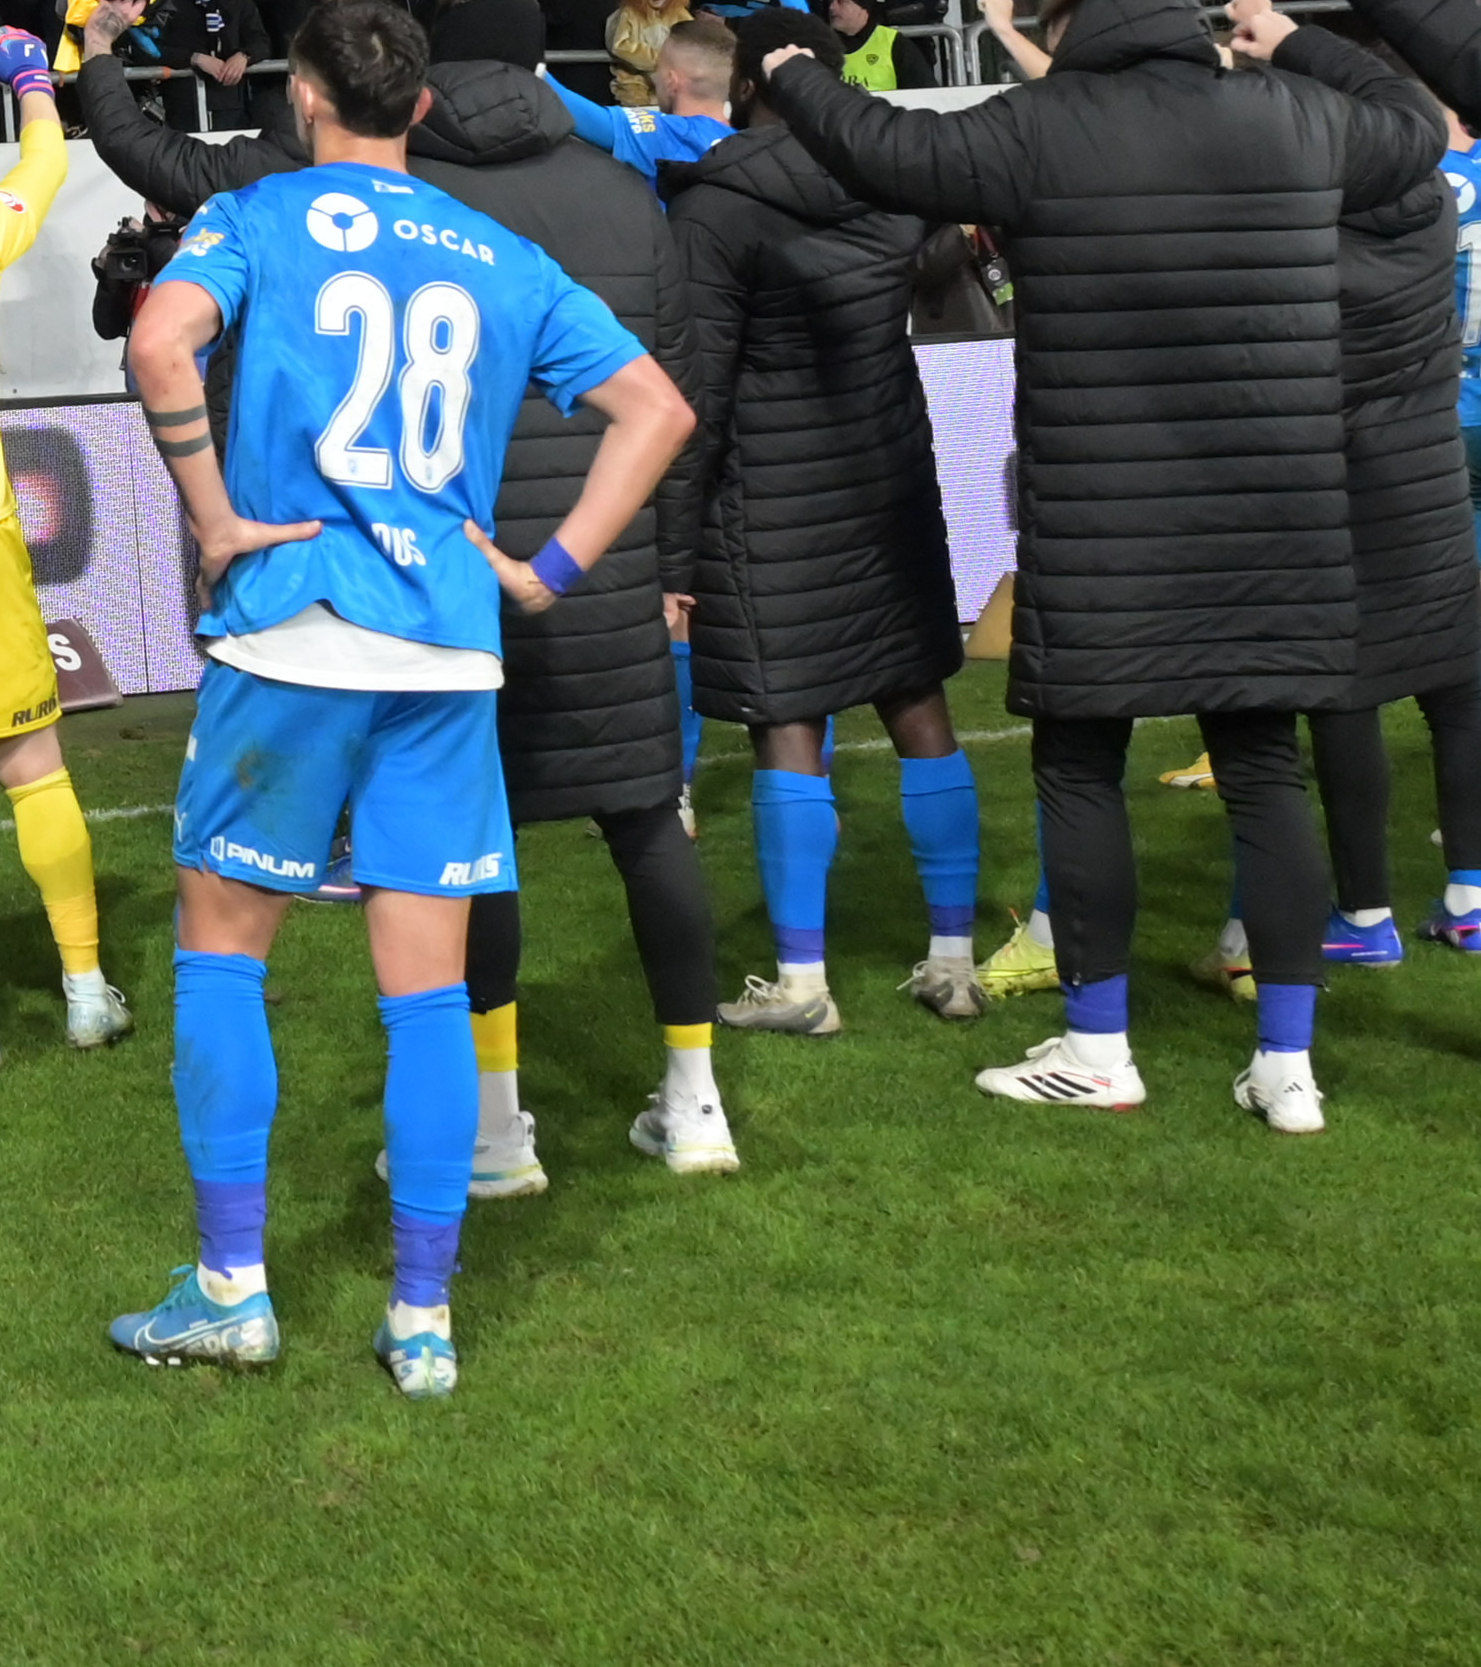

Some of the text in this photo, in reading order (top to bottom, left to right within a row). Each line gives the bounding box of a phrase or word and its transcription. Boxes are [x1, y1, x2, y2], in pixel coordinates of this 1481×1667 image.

[392, 218, 496, 267] OSCAR
[314, 270, 482, 494] 28
[226, 849, 316, 879] PINUM
